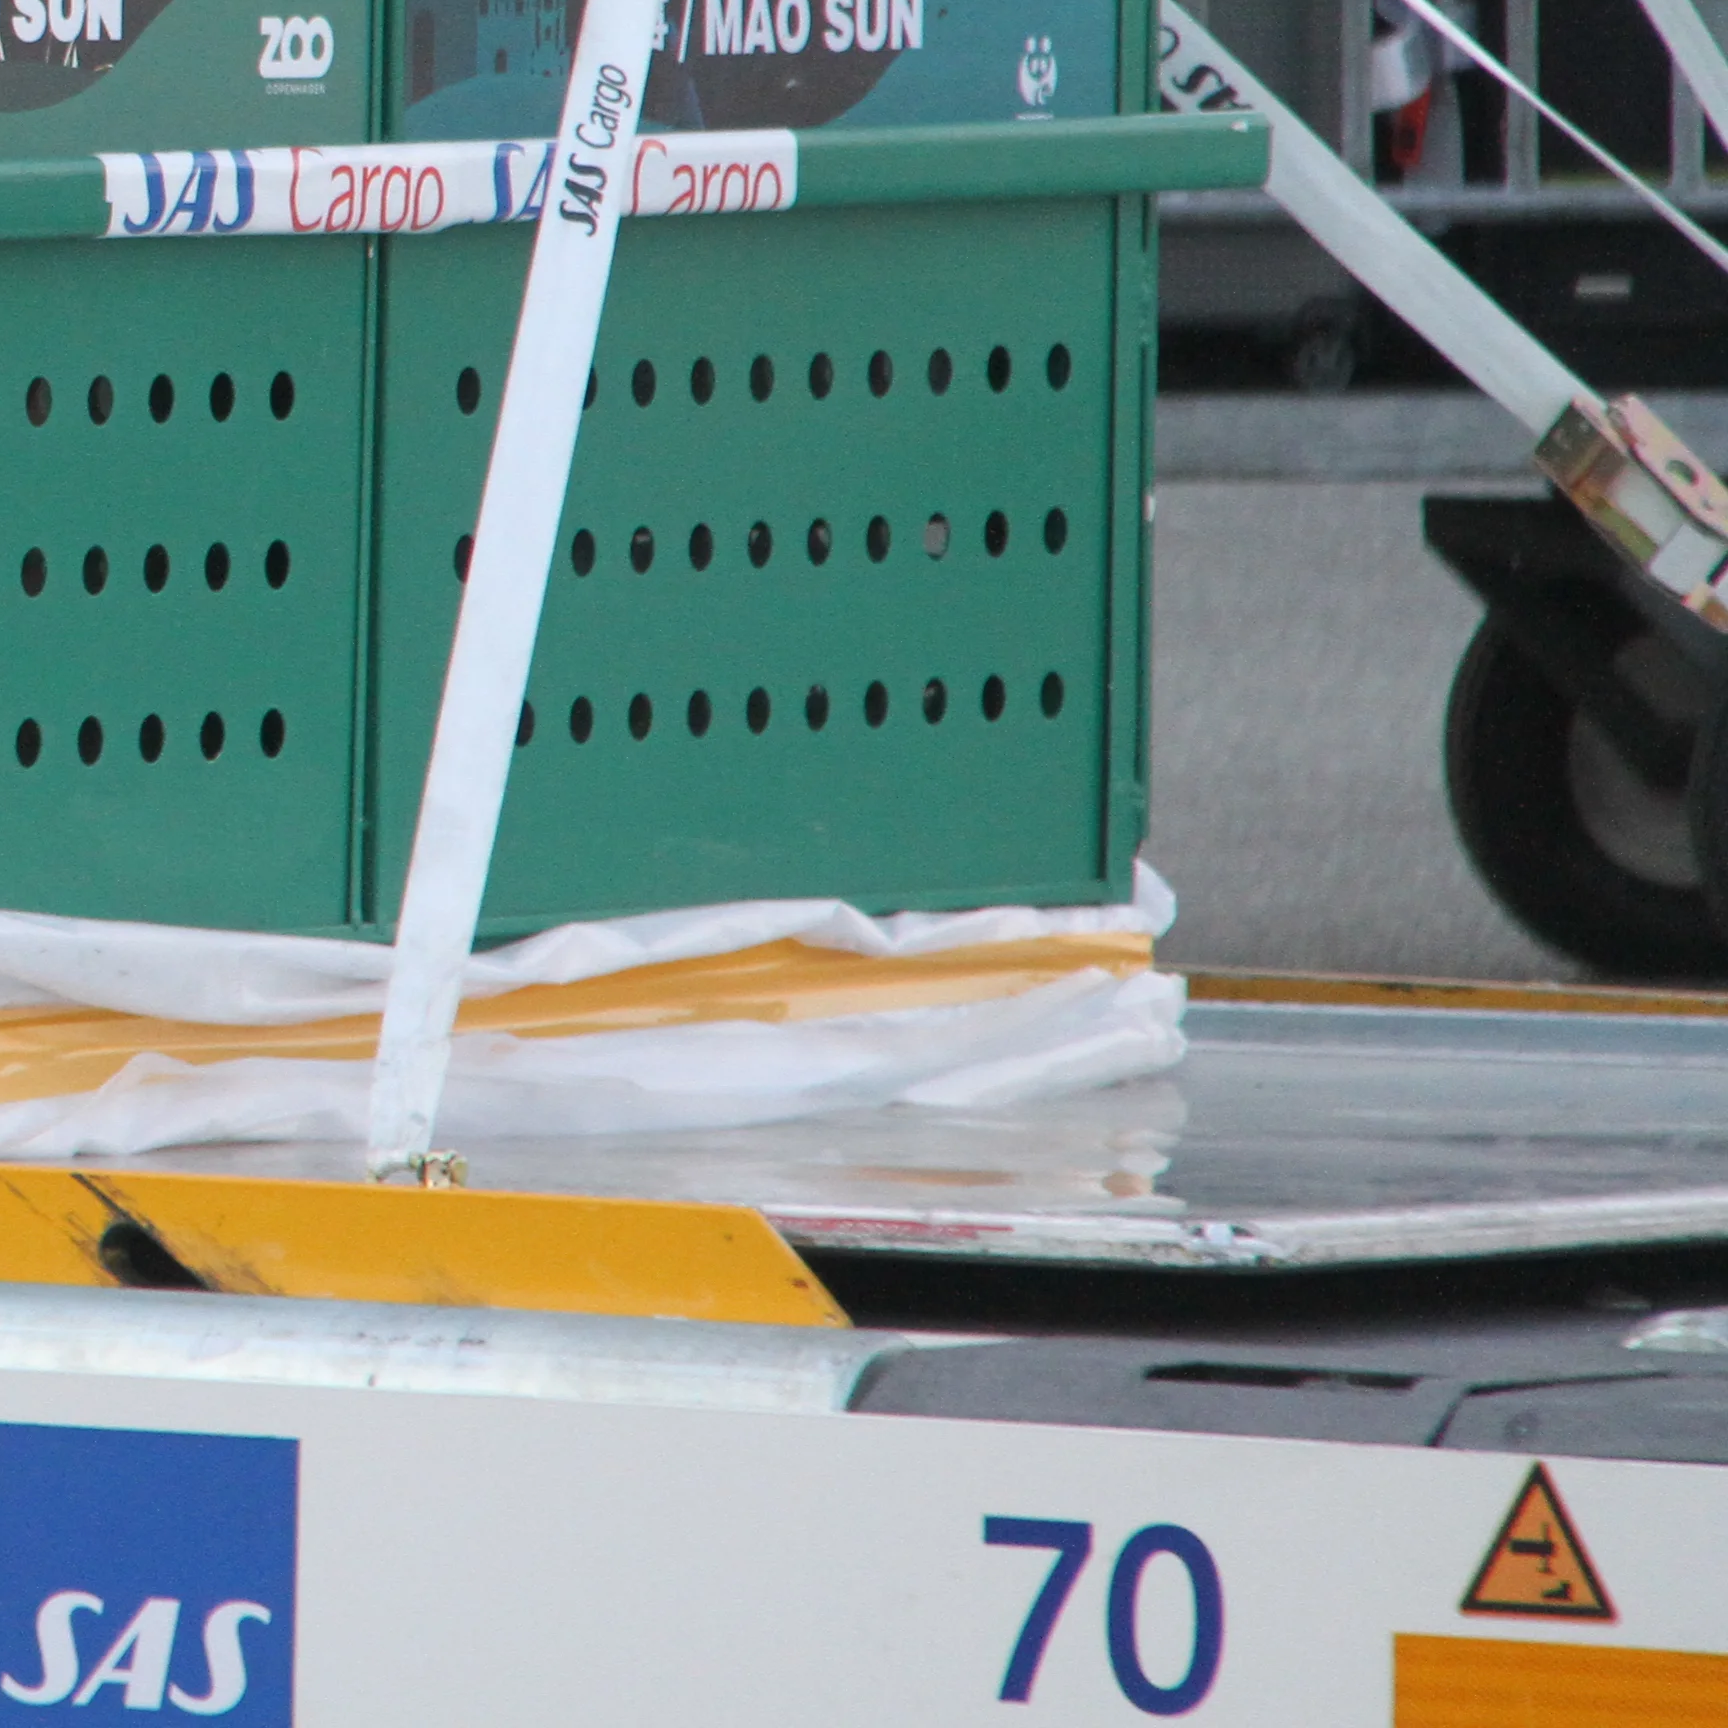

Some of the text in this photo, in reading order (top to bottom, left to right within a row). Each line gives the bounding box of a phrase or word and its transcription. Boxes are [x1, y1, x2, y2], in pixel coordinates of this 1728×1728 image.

[258, 15, 334, 79] ZOO
[559, 63, 632, 238] SAS Cargo
[0, 1590, 273, 1718] SAS
[981, 1513, 1228, 1718] 70
